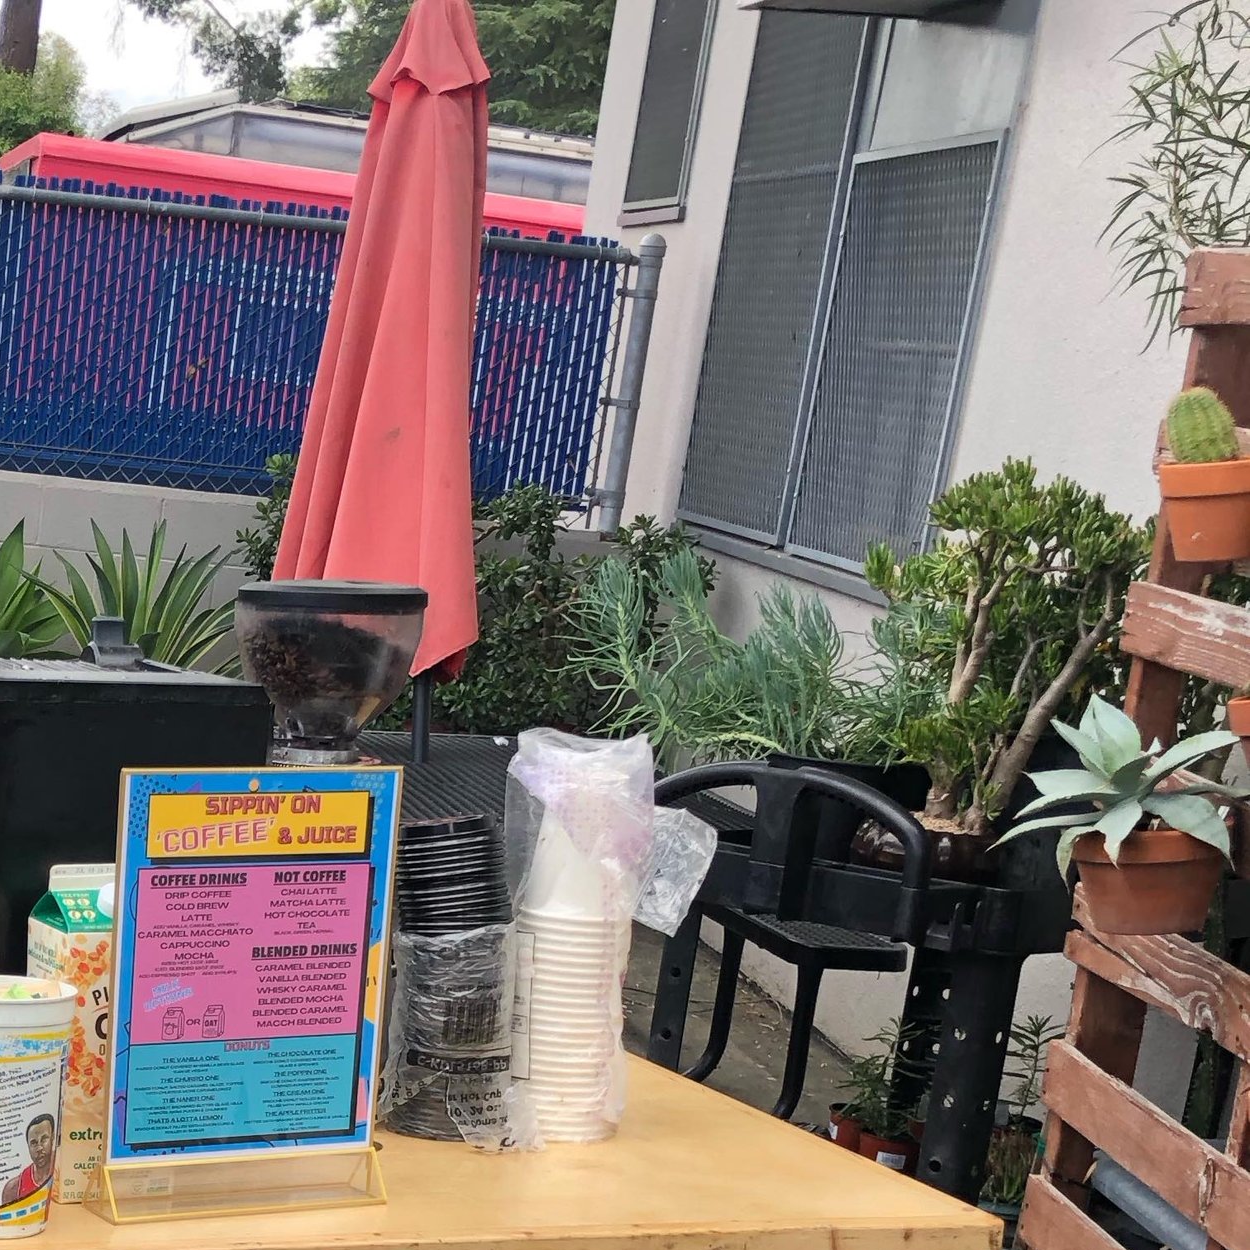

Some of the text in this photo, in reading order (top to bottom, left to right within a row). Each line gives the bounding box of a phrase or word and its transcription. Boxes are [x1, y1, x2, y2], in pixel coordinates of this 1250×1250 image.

[205, 794, 321, 815] SIPPIN' ON
[277, 827, 292, 845] &
[297, 825, 357, 845] JUICE
[150, 872, 248, 887] COFFEE DRINKS
[274, 870, 346, 883] NOT COFFEE
[165, 890, 232, 900] DRIP COFFEE
[280, 887, 338, 896] CHAI LATTE
[166, 902, 230, 911] COLD BREW
[269, 898, 346, 908] MATCHA LATTE
[181, 914, 213, 922] LATTE
[264, 909, 350, 919] HOT CHOCOLATE
[297, 921, 316, 929] TEA
[137, 927, 254, 939] CARAMEL MACCHIATO
[160, 940, 230, 950] CAPPUCCINO
[251, 943, 358, 958] BLENDED DRINKS
[174, 951, 214, 961] MOCHA
[255, 961, 351, 973] CARAMEL BLENDED
[258, 972, 347, 983] VANILLA BLENDED
[256, 983, 347, 995] WHISKY CARAMEL
[258, 994, 344, 1006] BLENDED MOCHA
[252, 1005, 348, 1017] BLENDED CARAMEL
[185, 1018, 201, 1026] OR
[204, 1019, 218, 1027] OAT
[256, 1016, 342, 1028] MACCH BLENDED
[223, 1040, 271, 1053] DONUTS
